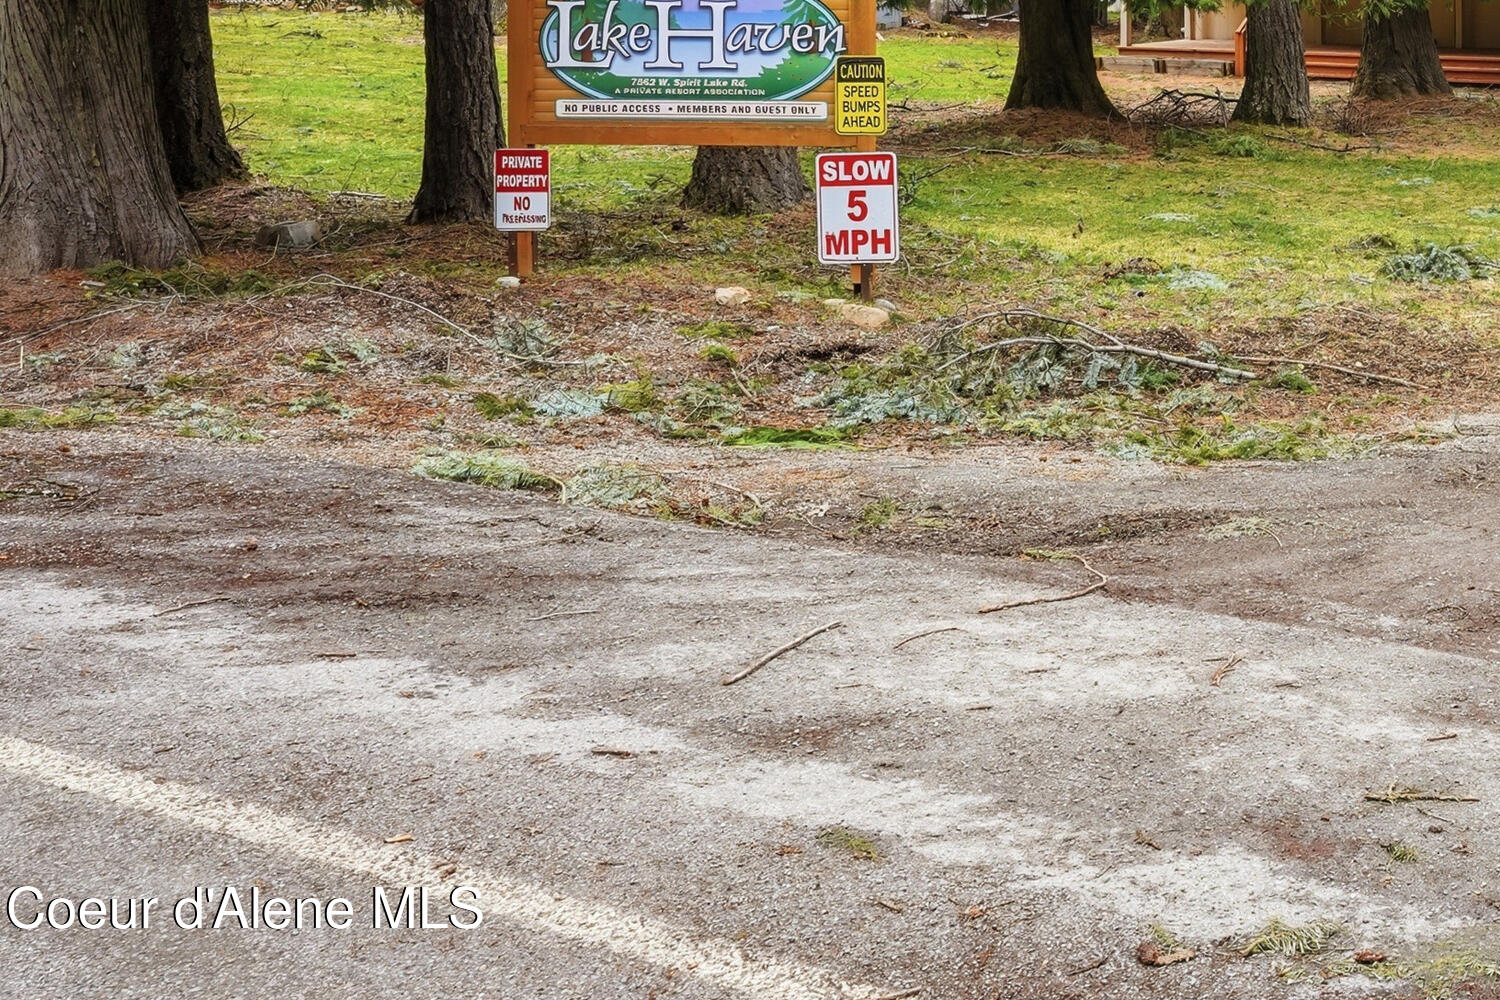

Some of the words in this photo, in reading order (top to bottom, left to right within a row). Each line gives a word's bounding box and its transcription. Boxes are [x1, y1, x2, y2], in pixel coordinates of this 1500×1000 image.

[546, 0, 653, 69] Lake
[643, 0, 848, 70] Haven
[840, 64, 883, 79] CAUTION
[658, 78, 671, 86] W.
[673, 78, 702, 88] Spirit
[703, 78, 729, 87] Lake
[731, 78, 748, 87] Rd.
[665, 88, 701, 96] RESORT
[703, 88, 766, 96] ASSOCIATION
[843, 85, 879, 98] SPEED
[564, 104, 578, 113] NO
[581, 104, 618, 113] PUBLIC
[621, 104, 661, 113] ACCESS
[676, 105, 728, 114] MEMBERS
[731, 105, 751, 114] AND
[755, 105, 787, 114] GUEST
[791, 106, 817, 115] ONLY
[842, 101, 881, 113] BUMPS
[842, 116, 881, 128] AHEAD
[501, 155, 543, 169] PRIVATE
[822, 160, 891, 182] SLOW
[496, 174, 548, 188] PROPERTY
[513, 196, 531, 211] NO
[847, 190, 869, 222] 5
[825, 229, 892, 256] MPH
